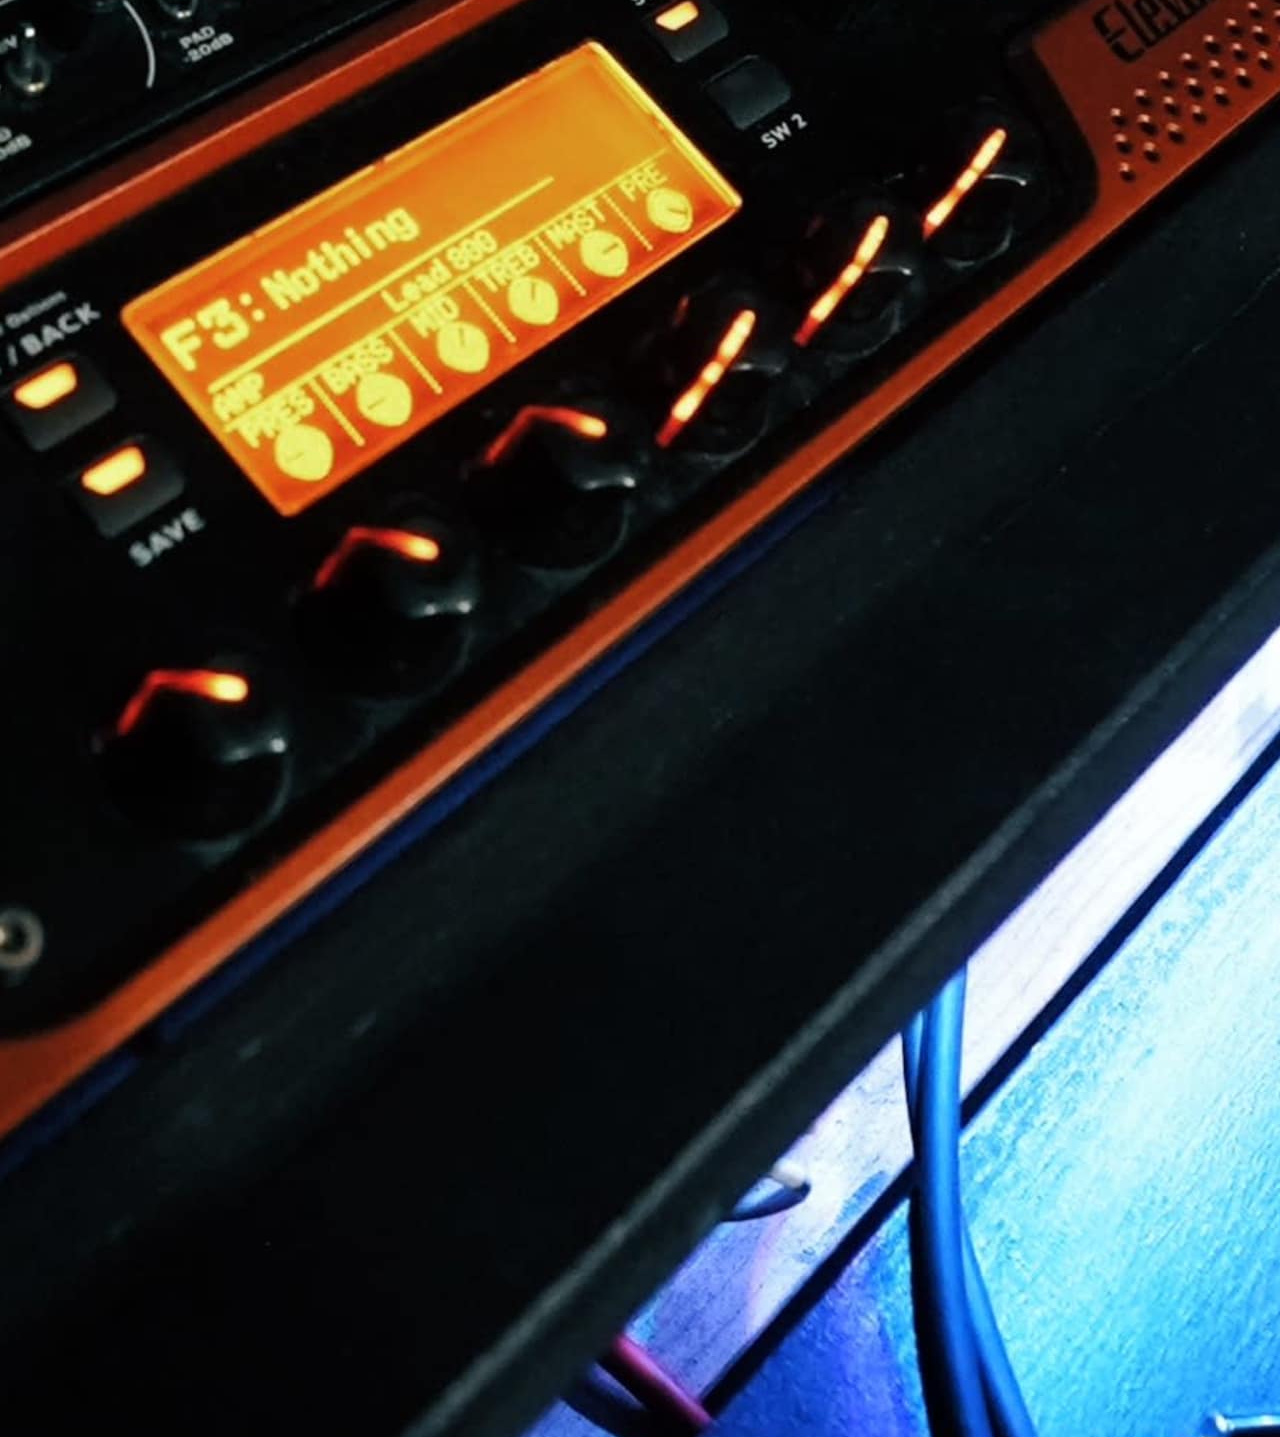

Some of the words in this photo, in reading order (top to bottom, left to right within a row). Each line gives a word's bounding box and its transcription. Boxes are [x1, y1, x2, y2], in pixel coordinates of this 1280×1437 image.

[179, 25, 216, 50] PAD
[760, 122, 793, 150] SW
[617, 160, 669, 203] PRE
[473, 243, 541, 295] TREB
[19, 301, 102, 358] BACK
[408, 292, 460, 339] MID
[128, 507, 206, 568] SAVE
